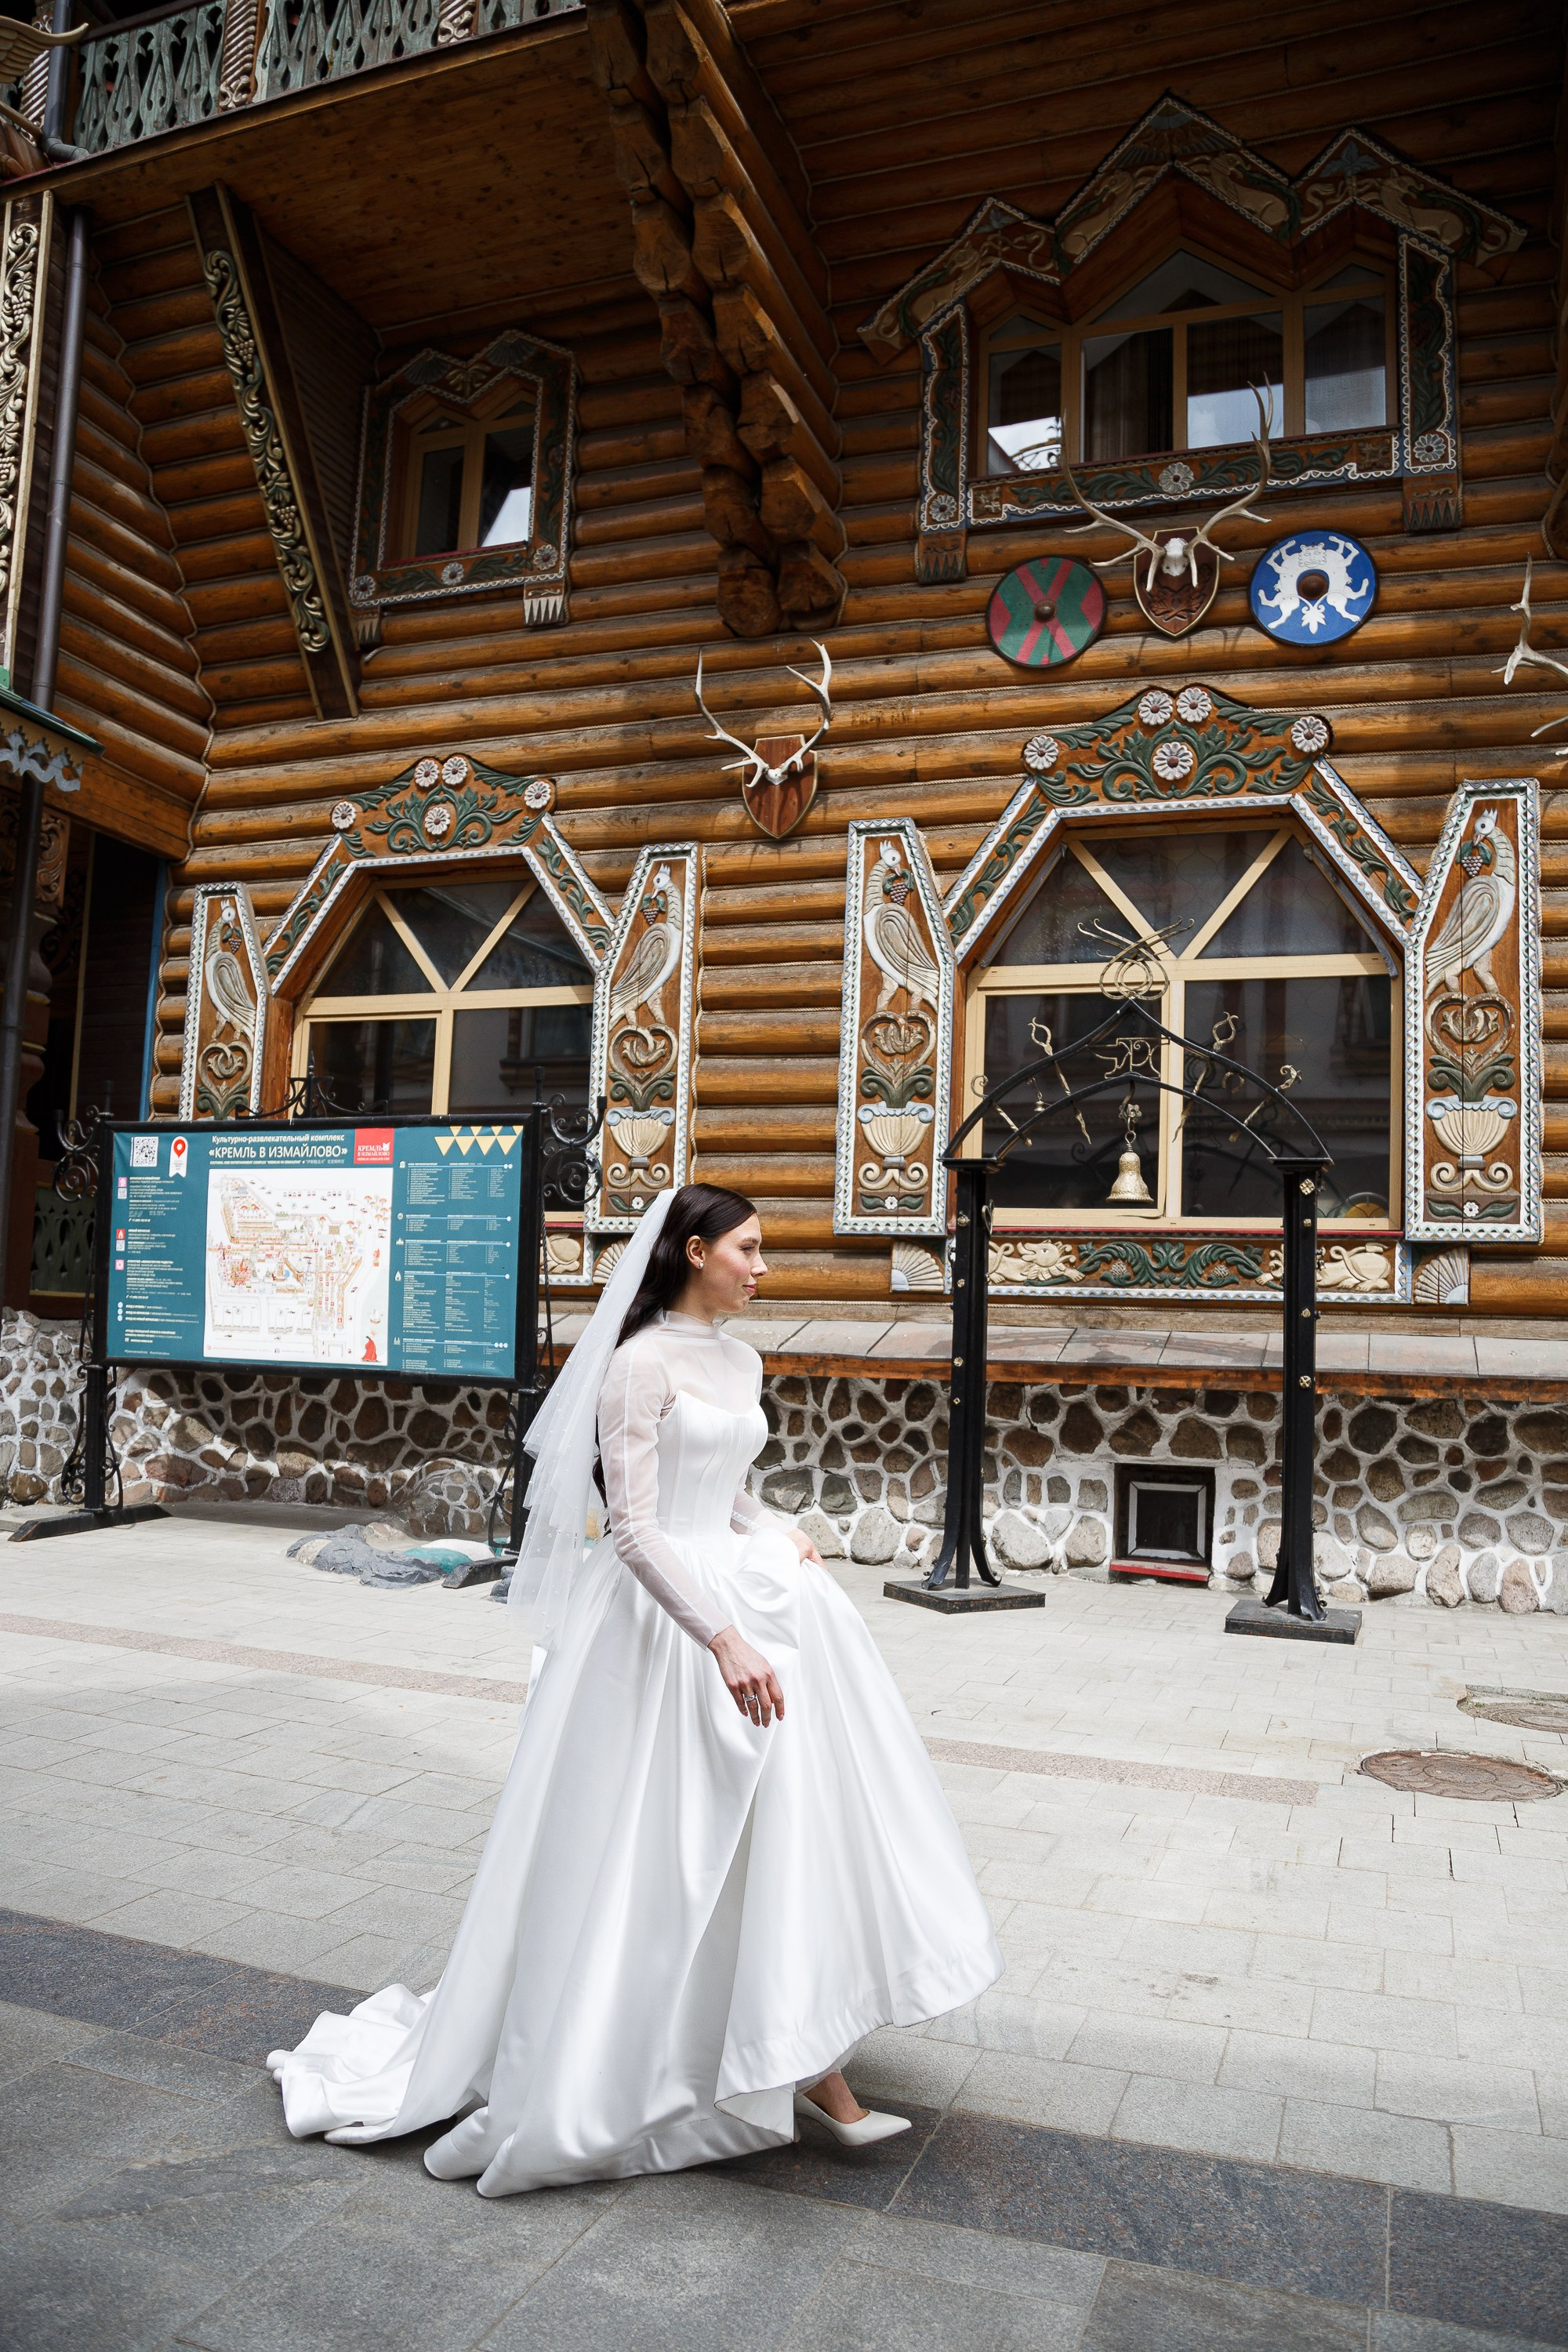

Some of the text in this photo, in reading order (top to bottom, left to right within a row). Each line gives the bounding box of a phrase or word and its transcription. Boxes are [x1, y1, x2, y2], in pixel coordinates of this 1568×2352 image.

[212, 1134, 310, 1144] Культурно-развлекательный
[209, 1143, 347, 1158] «КРЕМЛЬ В ИЗМАЙЛОВО»
